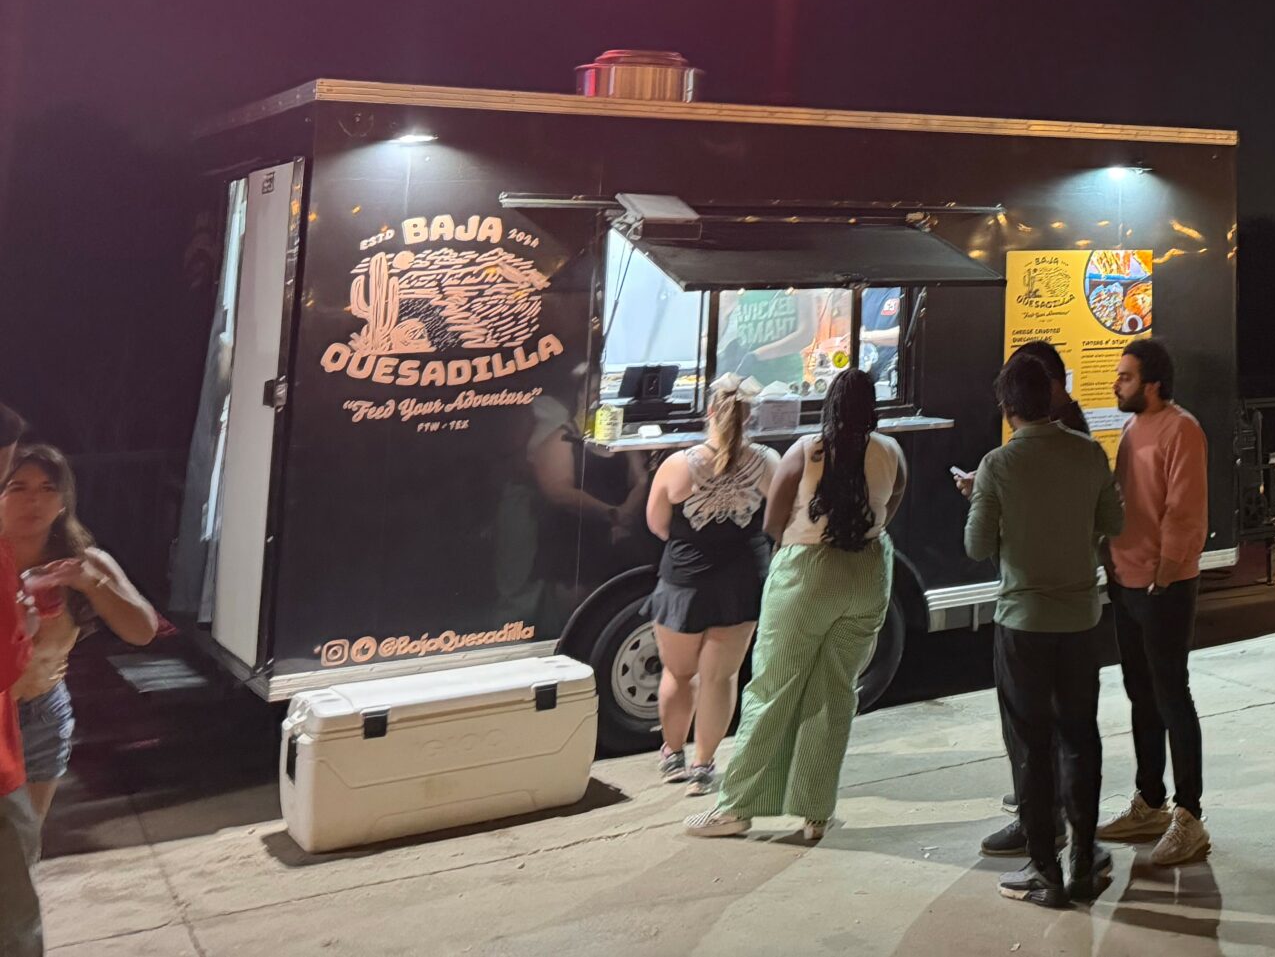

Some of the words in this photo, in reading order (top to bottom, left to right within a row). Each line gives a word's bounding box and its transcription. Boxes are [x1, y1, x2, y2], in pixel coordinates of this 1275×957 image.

[401, 215, 503, 245] BAJA
[320, 333, 564, 387] QUESADILLA
[398, 397, 445, 422] Your
